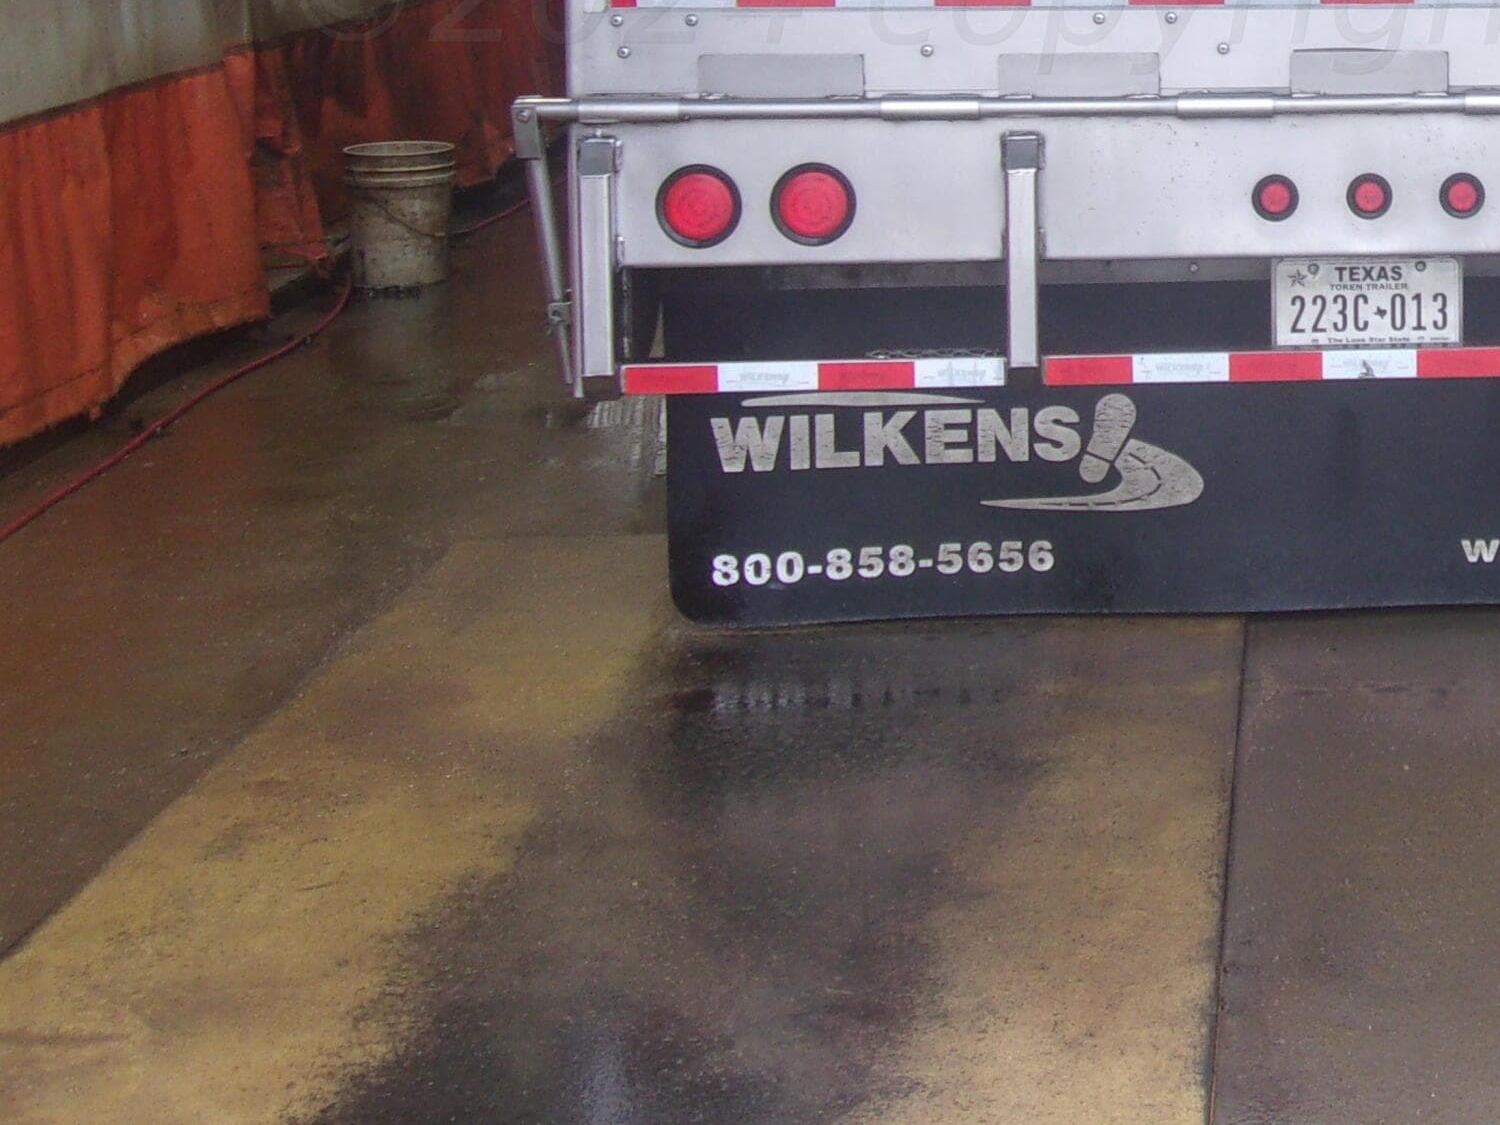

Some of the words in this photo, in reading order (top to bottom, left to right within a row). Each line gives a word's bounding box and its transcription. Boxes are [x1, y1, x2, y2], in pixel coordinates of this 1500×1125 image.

[1329, 283, 1364, 292] TOKEN
[1366, 282, 1409, 291] TRAILER
[1334, 265, 1403, 282] TEXAS
[709, 406, 1083, 473] WILKENS
[712, 540, 1056, 587] 800-858-5656
